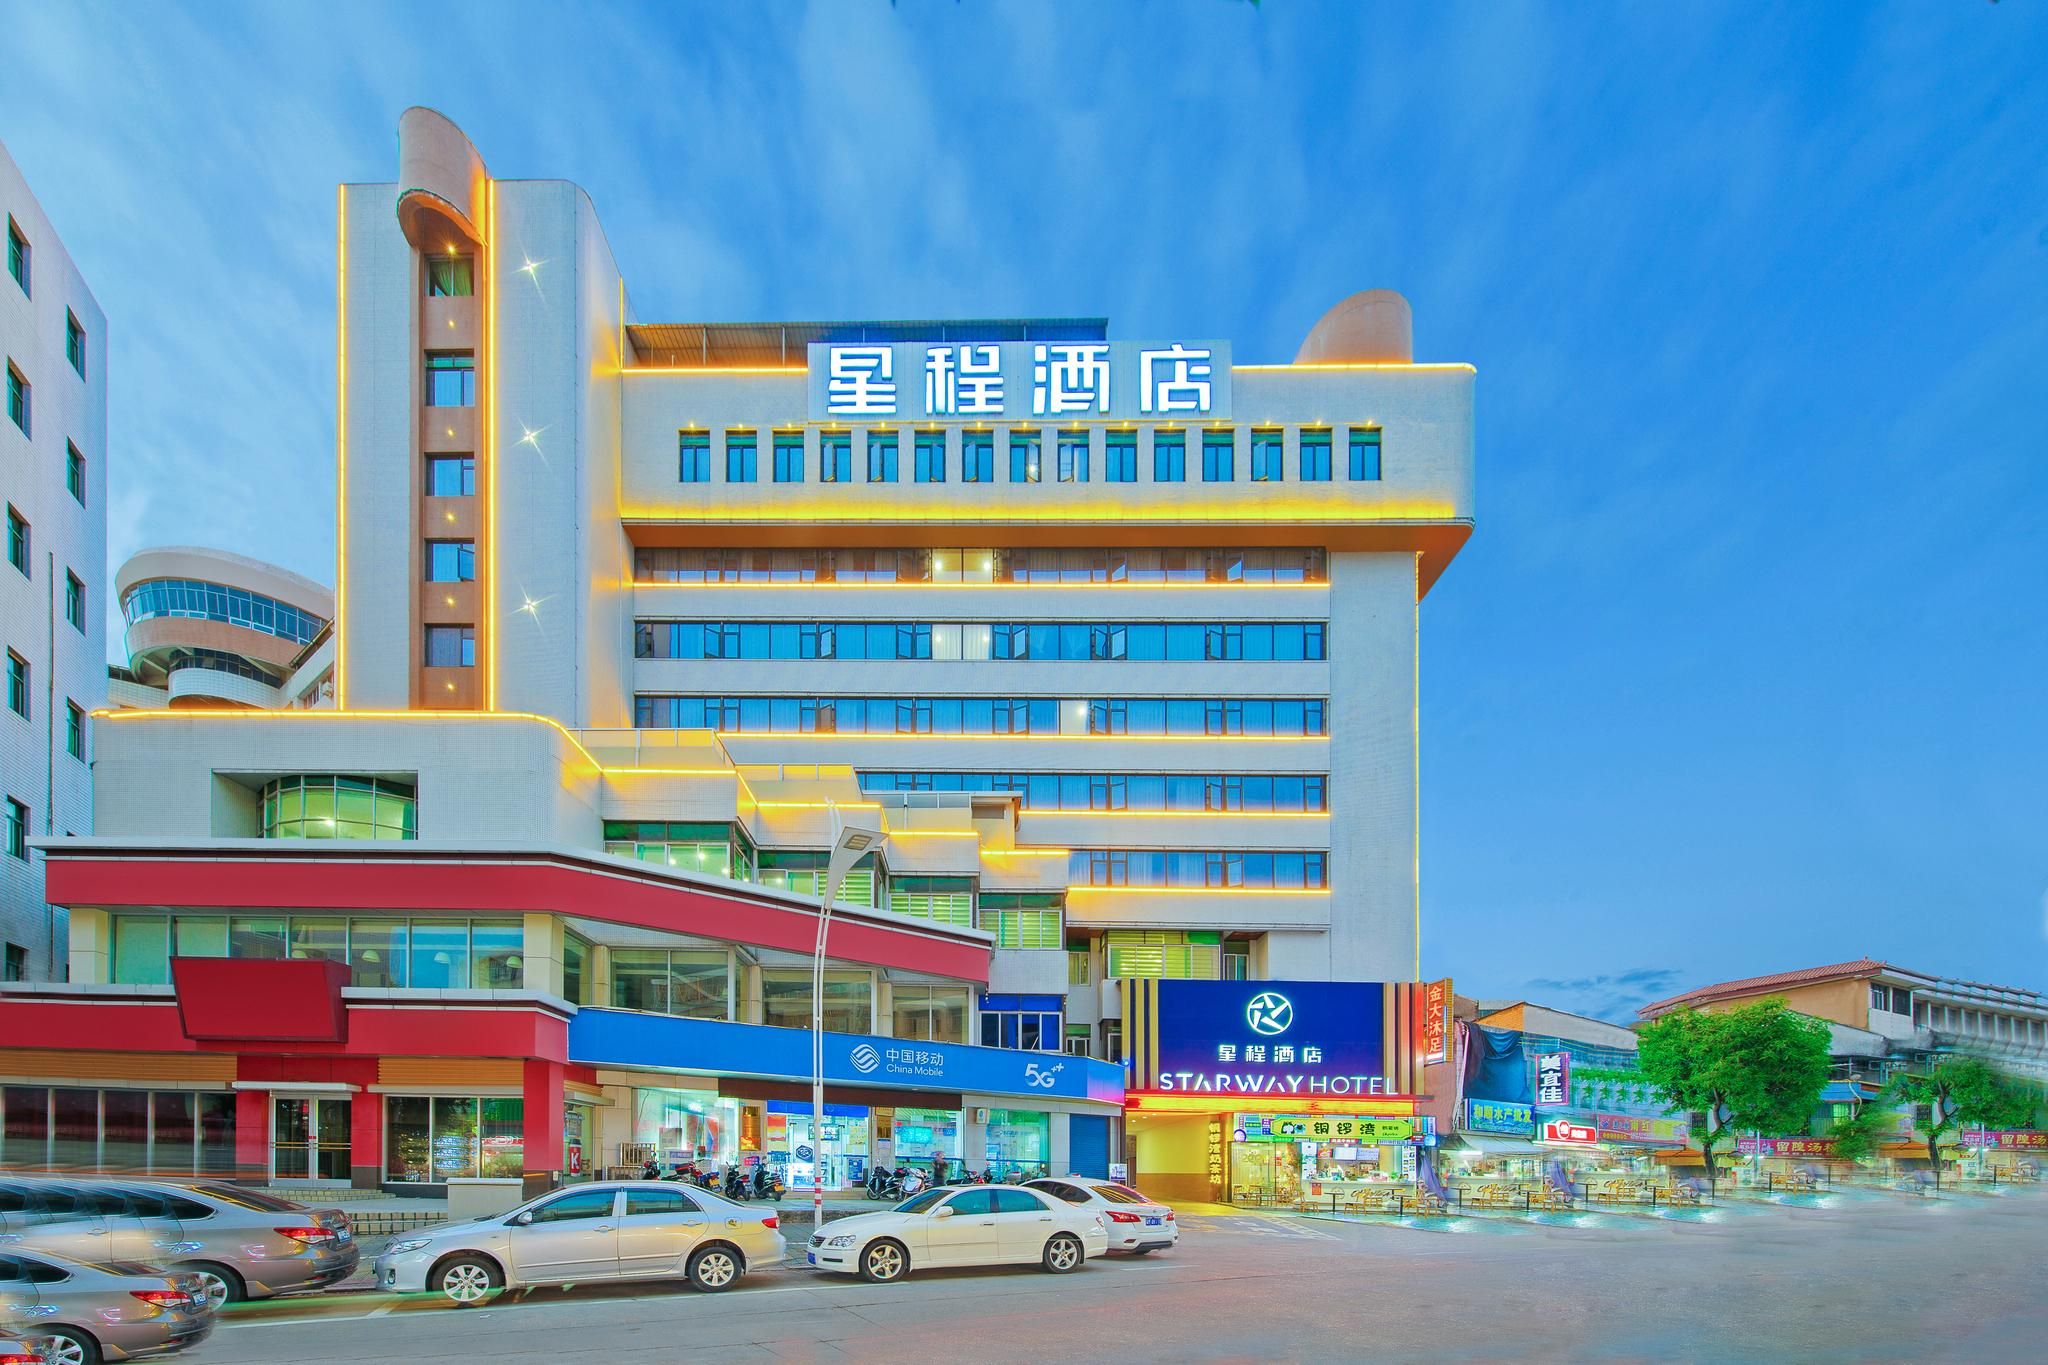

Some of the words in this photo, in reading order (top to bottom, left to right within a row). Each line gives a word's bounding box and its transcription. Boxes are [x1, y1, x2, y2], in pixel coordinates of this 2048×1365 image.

[827, 344, 1211, 414] 星程酒店
[1429, 986, 1443, 1053] 金大沐足
[886, 1048, 944, 1067] 中国移动
[1218, 1044, 1322, 1063] 星程酒店
[886, 1064, 913, 1075] China
[914, 1066, 944, 1077] Mobile
[1540, 1055, 1563, 1102] 美宜佳
[1159, 1073, 1304, 1093] STARWAY
[1310, 1076, 1399, 1095] HOTEL
[1313, 1121, 1376, 1136] 铜锣湾
